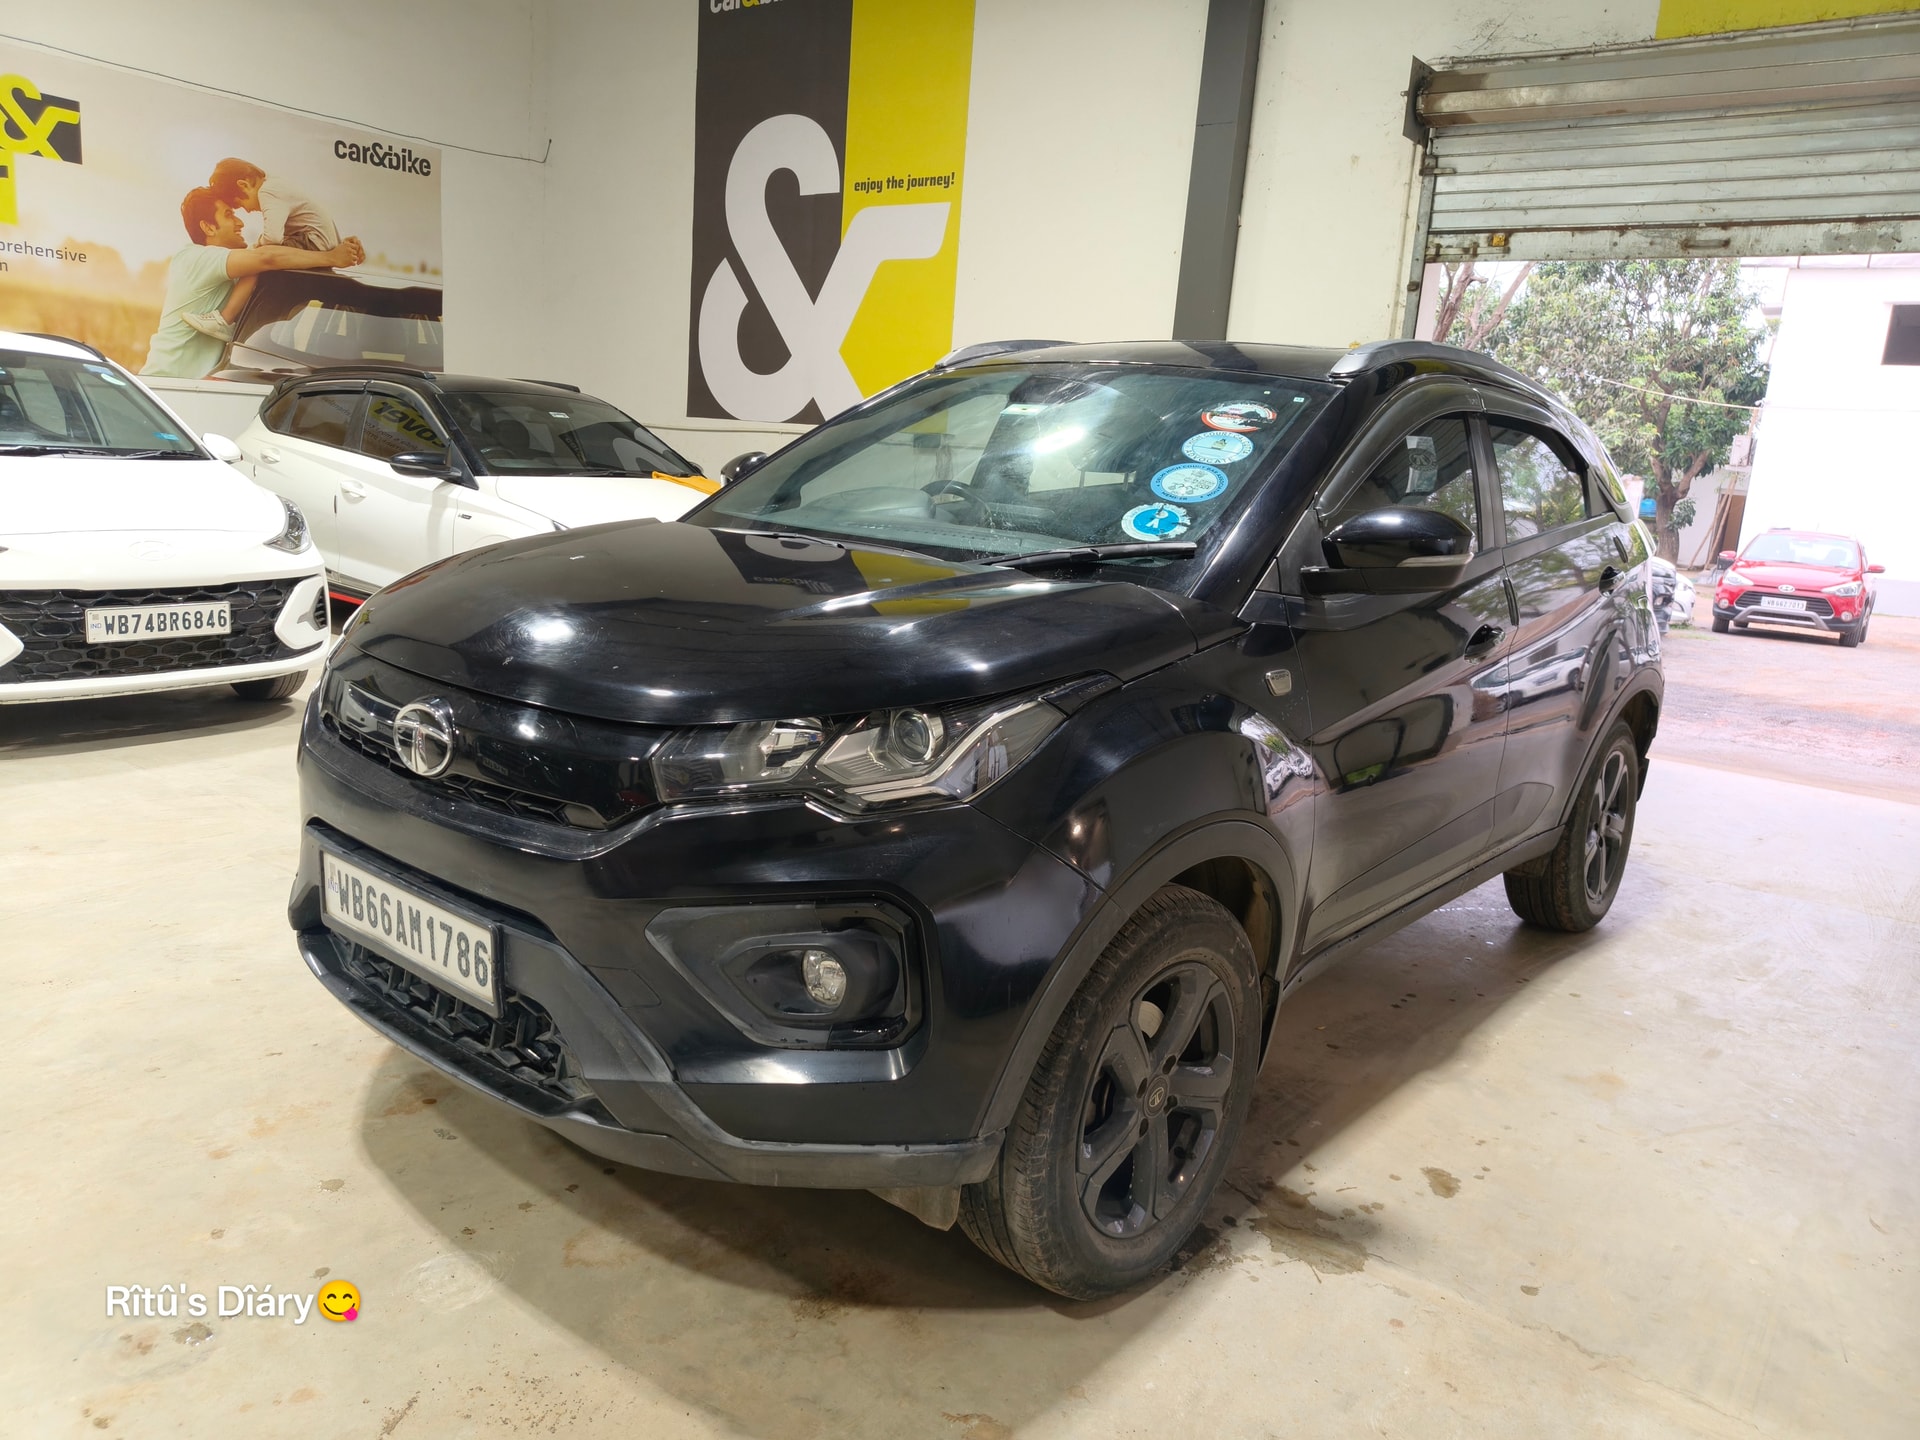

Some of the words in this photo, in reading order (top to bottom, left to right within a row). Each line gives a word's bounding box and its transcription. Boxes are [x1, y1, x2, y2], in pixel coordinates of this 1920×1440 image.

[333, 139, 432, 177] car&bike
[853, 178, 883, 194] enjoy
[886, 175, 905, 190] the
[906, 171, 956, 192] journey!
[103, 609, 228, 636] WB74BR6846
[337, 869, 489, 988] WB66AM1786
